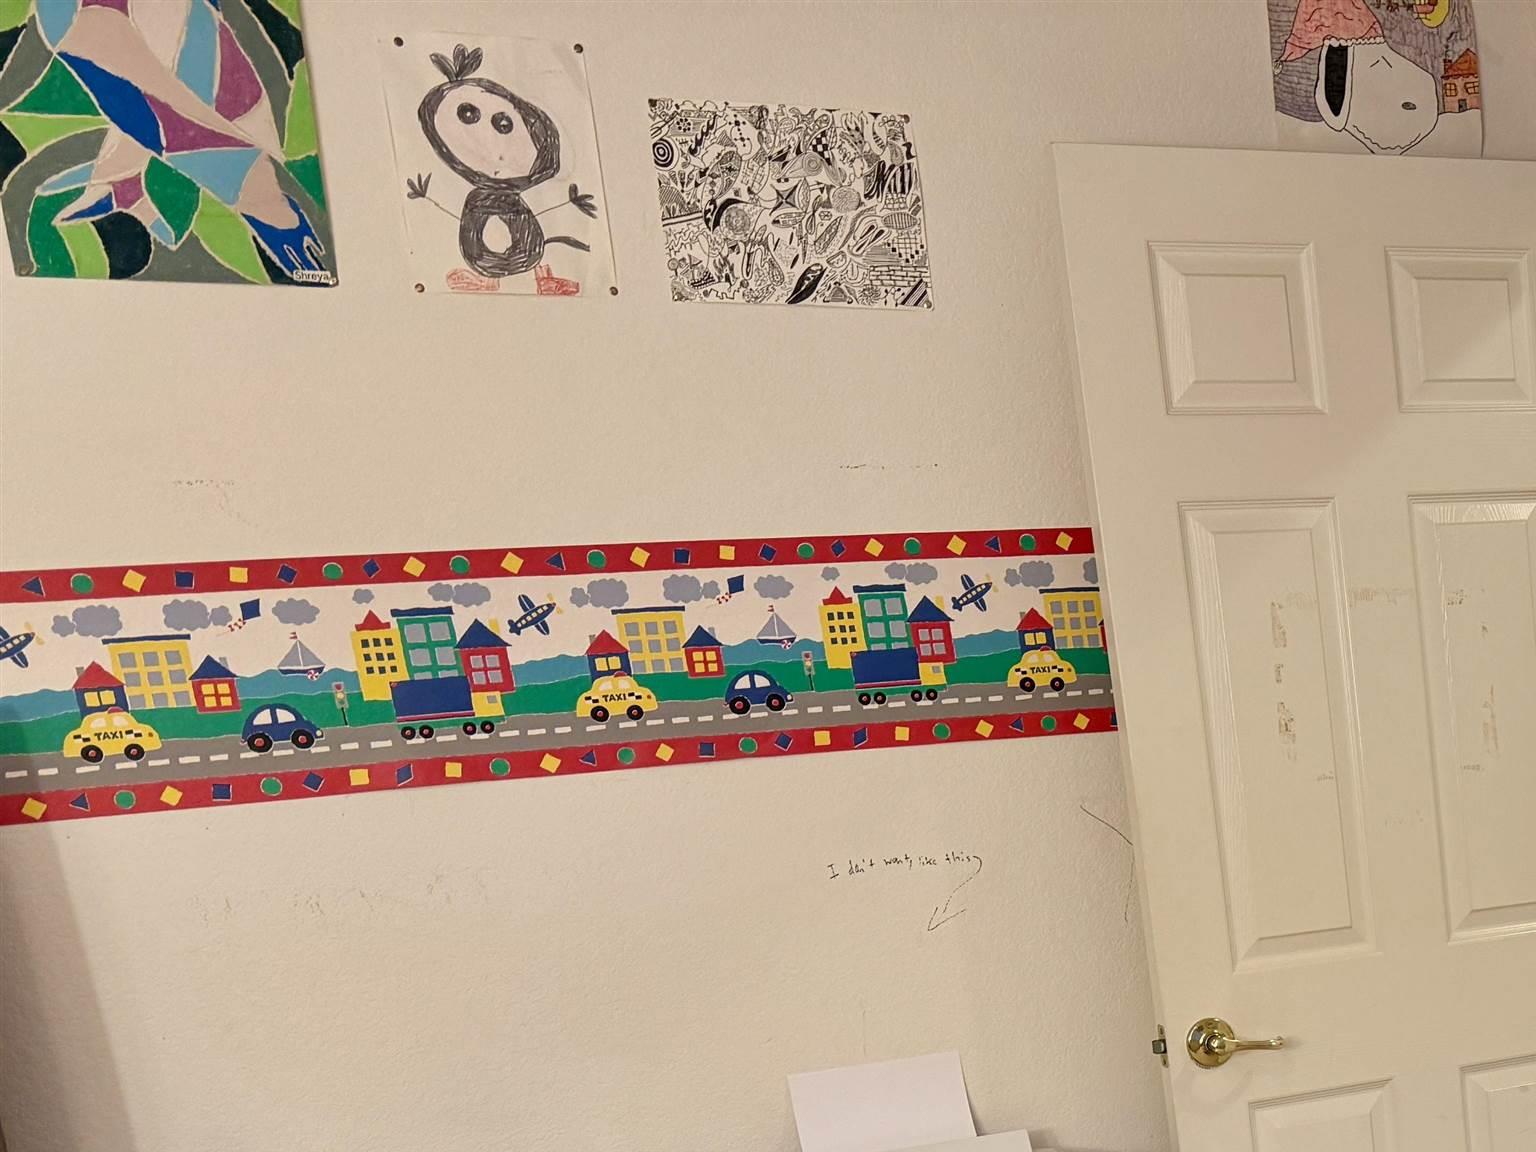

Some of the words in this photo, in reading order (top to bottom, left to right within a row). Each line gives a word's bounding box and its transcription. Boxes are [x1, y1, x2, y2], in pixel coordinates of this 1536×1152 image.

[295, 271, 329, 283] Shreya
[1029, 665, 1051, 674] TAXI
[602, 693, 627, 703] TAXI
[94, 730, 124, 742] TAXI
[827, 863, 840, 879] I
[945, 850, 971, 864] this
